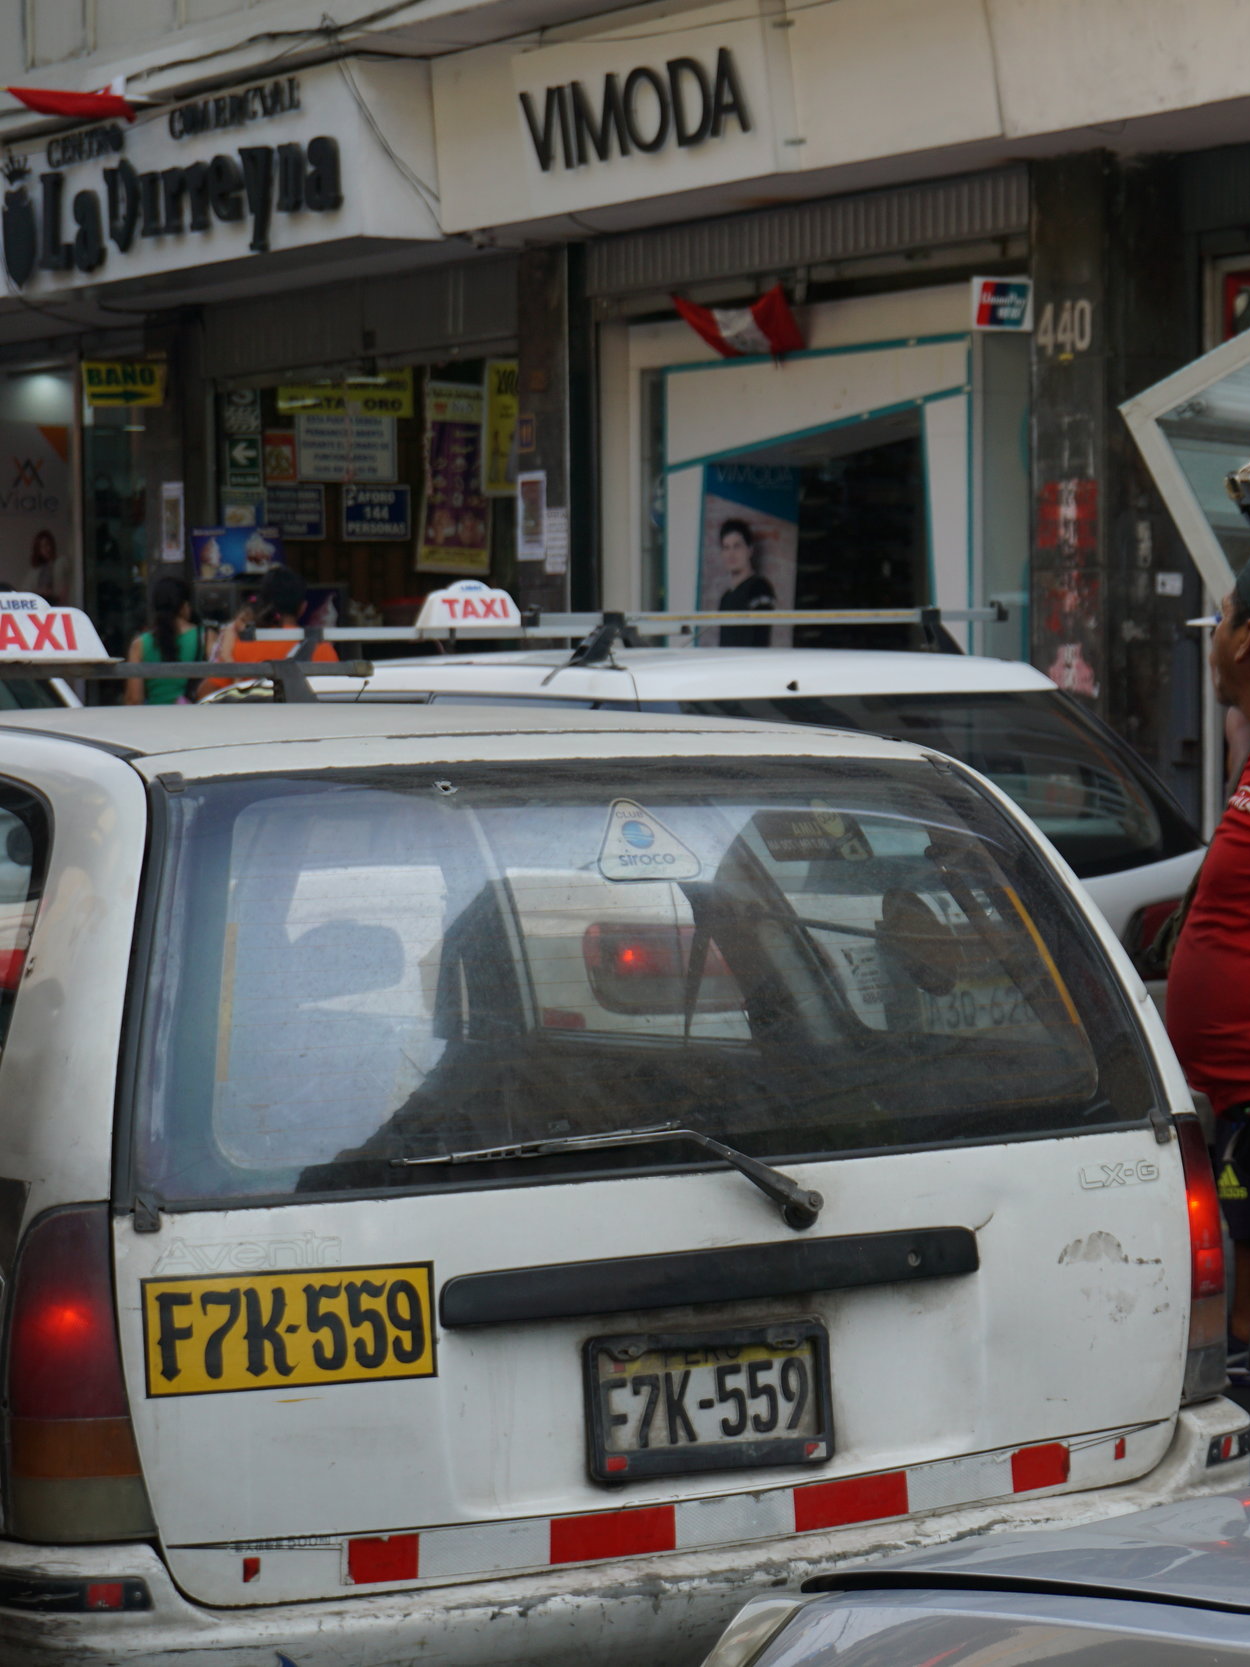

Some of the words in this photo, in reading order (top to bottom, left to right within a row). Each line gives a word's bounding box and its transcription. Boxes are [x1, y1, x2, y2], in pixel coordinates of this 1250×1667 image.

[46, 124, 125, 169] CENTRO
[169, 76, 301, 140] COMERCIAL
[519, 46, 751, 172] VIMODA
[39, 171, 107, 273] La
[103, 135, 344, 253] Virreyna
[1036, 299, 1092, 357] 440
[0, 598, 38, 611] LIBRE
[441, 597, 510, 619] TAXI
[0, 612, 79, 651] AXI
[615, 810, 644, 819] CLUB
[618, 849, 676, 867] siroco
[1079, 1159, 1160, 1190] LX-G
[151, 1230, 342, 1277] Avenir
[154, 1279, 426, 1383] F7K-559
[601, 1356, 809, 1449] F7K-559
